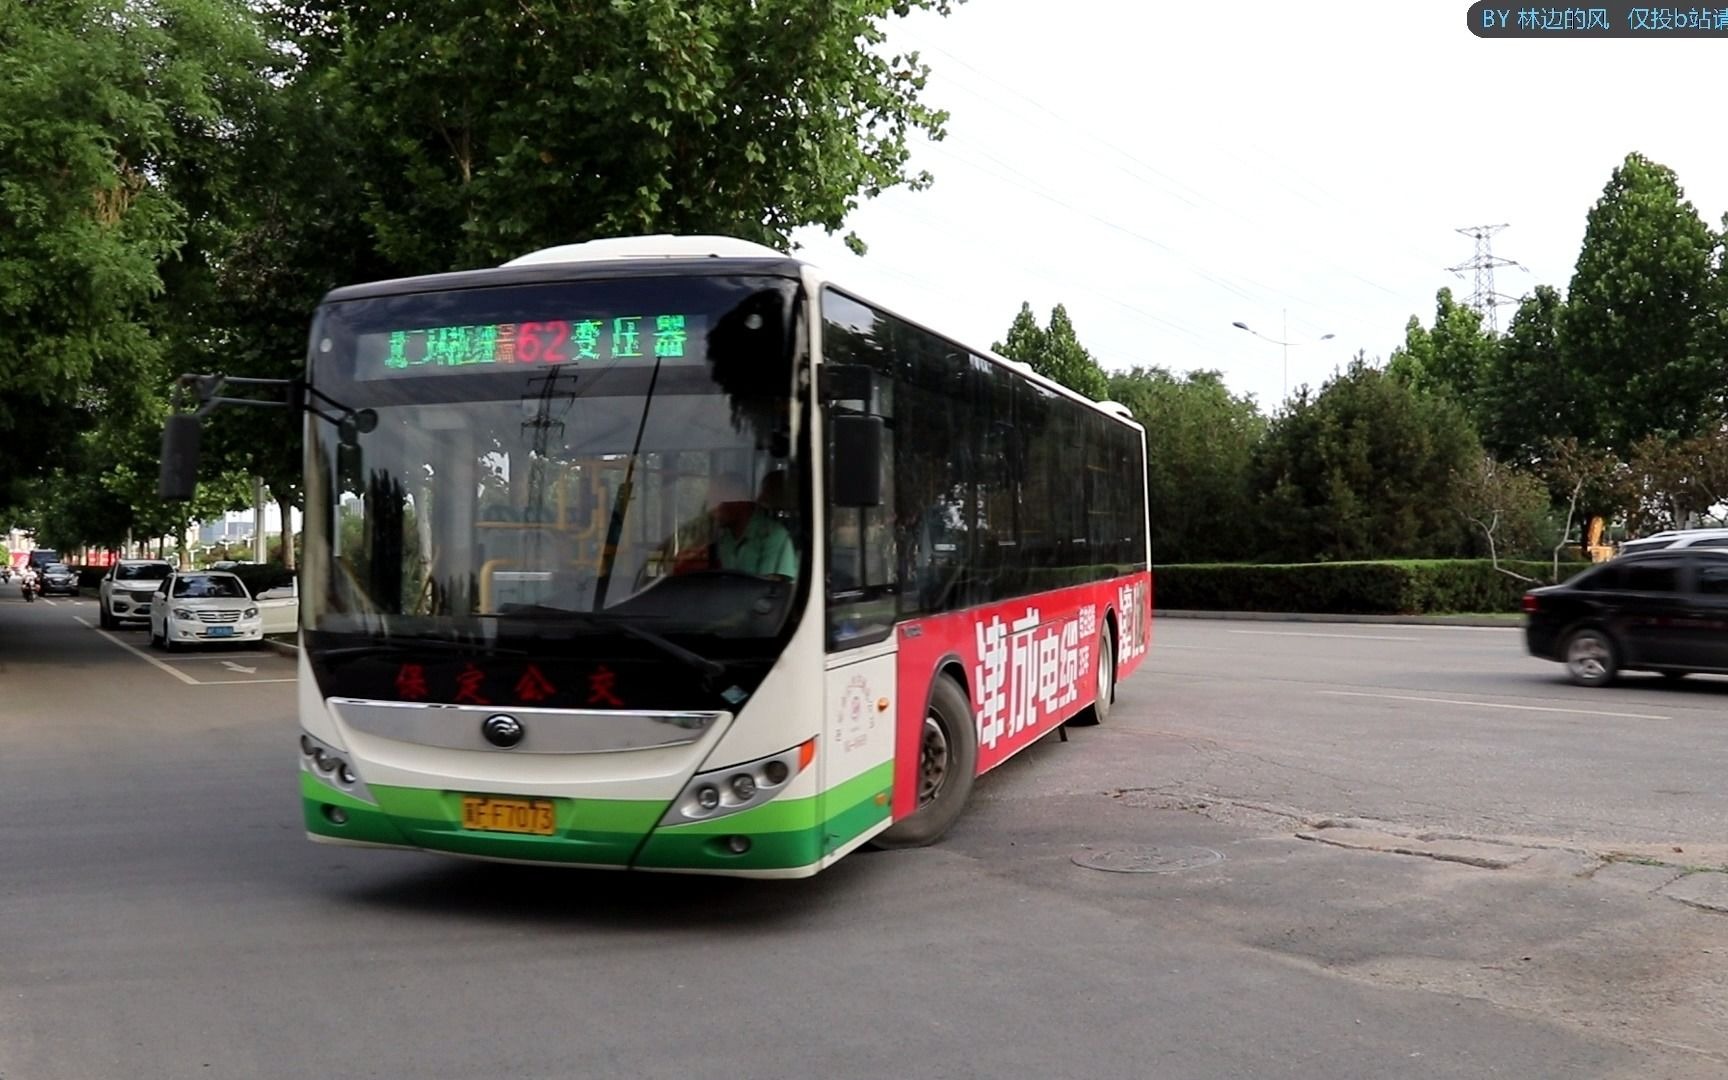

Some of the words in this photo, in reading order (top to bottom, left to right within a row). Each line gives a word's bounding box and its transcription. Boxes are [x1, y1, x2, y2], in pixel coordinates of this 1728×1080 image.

[515, 319, 570, 363] 62
[571, 314, 688, 361] 变压器
